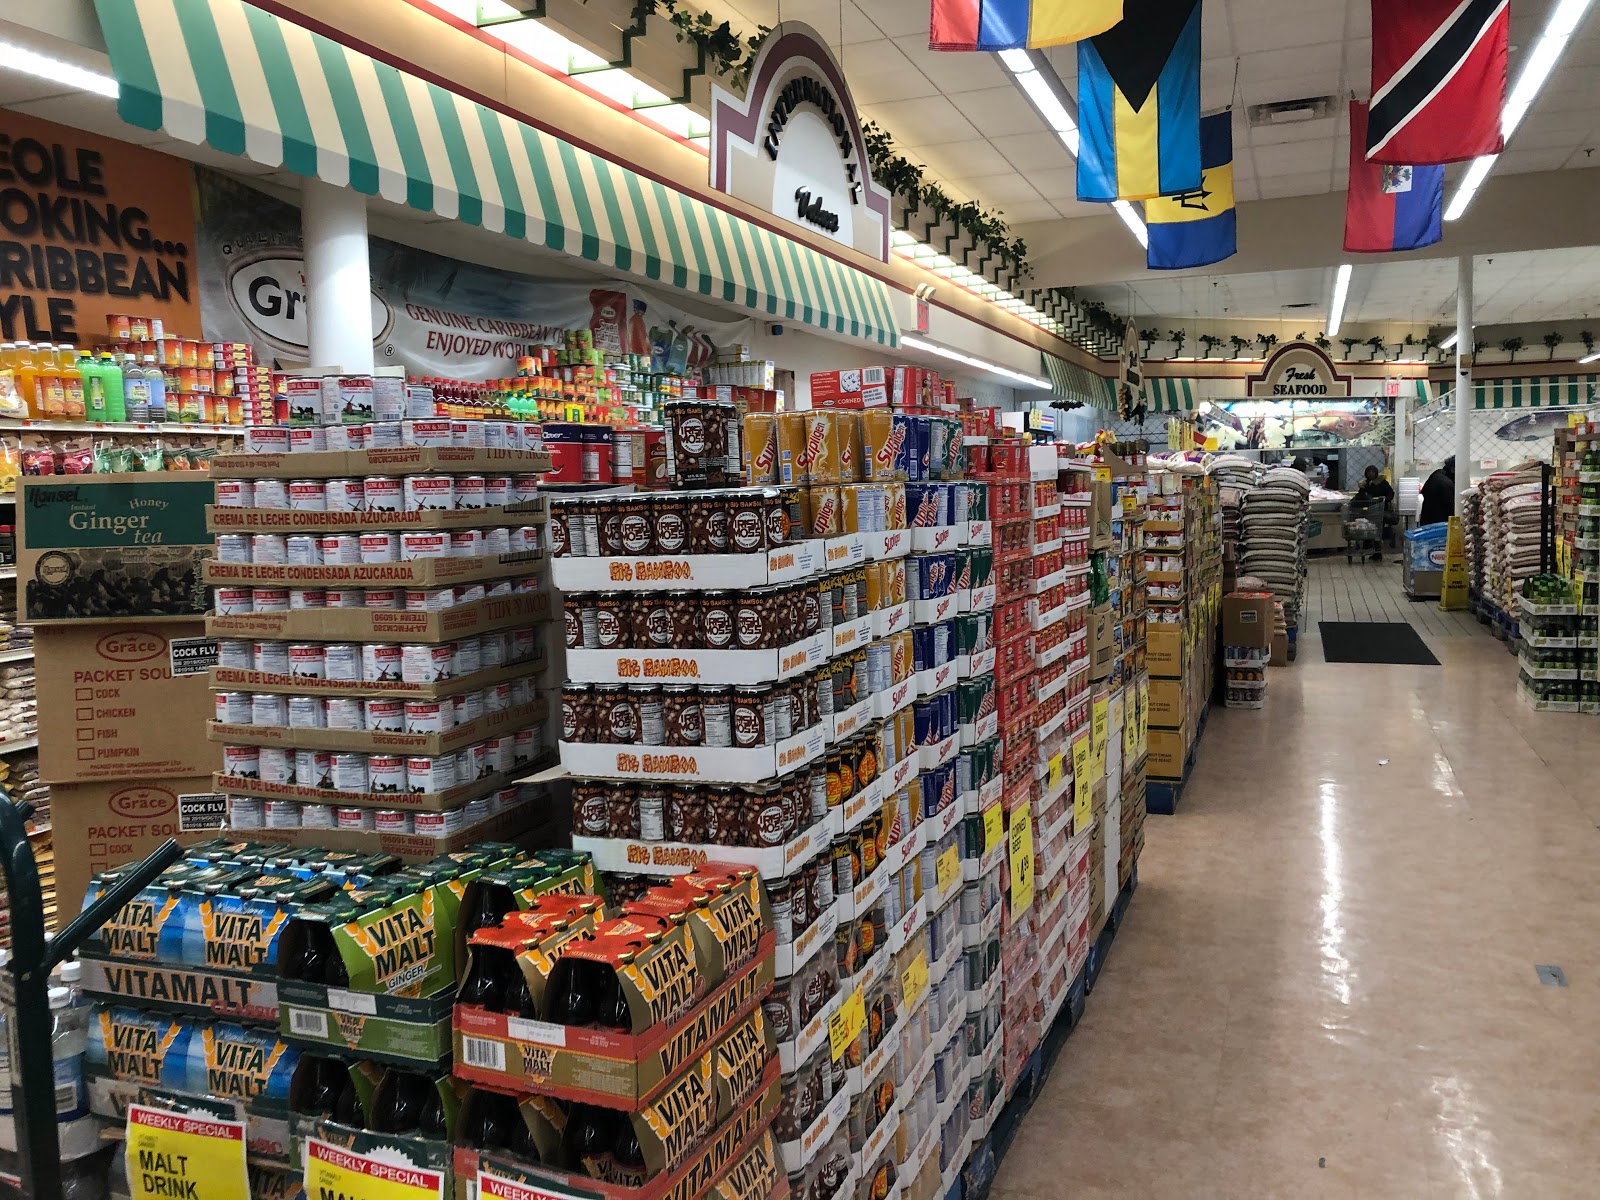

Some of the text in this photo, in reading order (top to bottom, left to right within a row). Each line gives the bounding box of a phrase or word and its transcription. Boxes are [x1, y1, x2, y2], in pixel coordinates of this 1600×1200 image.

[0, 240, 191, 304] RIBBEAN
[405, 303, 477, 332] GENUINE
[477, 317, 553, 342] CARIBBEAN
[426, 330, 491, 357] ENJOYED
[1286, 367, 1316, 382] Fresh
[1273, 384, 1328, 395] SEAFOOD
[1388, 384, 1399, 396] EXIT
[838, 397, 862, 405] CORNED
[418, 423, 431, 431] COW
[417, 480, 429, 488] COW
[71, 503, 97, 511] Instant
[129, 498, 170, 511] Honey
[69, 511, 150, 535] Ginger
[213, 511, 421, 526] CREMA DE LECHE CONDENSADA AZUCARADA
[733, 519, 760, 529] IRISH
[621, 523, 647, 532] IRISH
[657, 523, 683, 531] IRISH
[734, 528, 762, 538] MOSS
[134, 529, 163, 544] tea
[621, 531, 650, 540] MOSS
[657, 531, 685, 540] MOSS
[208, 565, 414, 579] CREMA DE LECHE CONDENSADA AZUCARADA
[705, 618, 730, 628] IRISH
[706, 627, 733, 636] MOSS
[105, 639, 158, 653] Grace
[173, 645, 219, 658] COCK FLV.
[74, 669, 136, 684] PACKET
[139, 668, 194, 682] SOU
[216, 670, 246, 682] CREMA
[249, 671, 260, 683] DE
[262, 673, 292, 686] LECHE
[96, 688, 121, 699] COCK
[96, 707, 136, 719] CHICKEN
[97, 729, 118, 739] FISH
[98, 747, 140, 758] PUMPKIN
[218, 775, 249, 789] CREMA
[251, 779, 262, 791] DE
[118, 795, 168, 810] Grace
[181, 802, 227, 814] COCK FLV.
[88, 824, 204, 840] PACKET SOU
[1011, 816, 1027, 840] CORNED
[109, 844, 134, 855] COCK
[1012, 839, 1022, 855] BEEF
[111, 902, 154, 927] VITA
[715, 893, 755, 934] VITA
[214, 914, 261, 942] VITA
[367, 907, 426, 949] VITA
[102, 927, 158, 954] MALT
[722, 917, 763, 965] MALT
[206, 941, 267, 967] MALT
[374, 929, 435, 980] MALT
[642, 941, 690, 991] VITA
[388, 965, 425, 989] GINGER
[103, 967, 252, 1008] VITAMALT
[650, 966, 699, 1026] MALT
[659, 968, 759, 1077] VITAMALT
[112, 1024, 156, 1053] VITA
[717, 1022, 759, 1069] VITA
[215, 1041, 263, 1072] VITA
[523, 1047, 547, 1059] VITA
[107, 1051, 163, 1082] MALT
[523, 1058, 551, 1070] MALT
[727, 1046, 767, 1098] MALT
[208, 1069, 267, 1098] MALT
[655, 1071, 705, 1128] VITA
[137, 1112, 234, 1139] WEEKLY SPECIAL
[664, 1098, 712, 1165] MALT
[139, 1150, 188, 1176] MALT
[317, 1146, 368, 1173] WEEKLY
[369, 1162, 429, 1188] SPECIAL
[729, 1145, 769, 1193] VITA
[142, 1173, 199, 1200] DRINK
